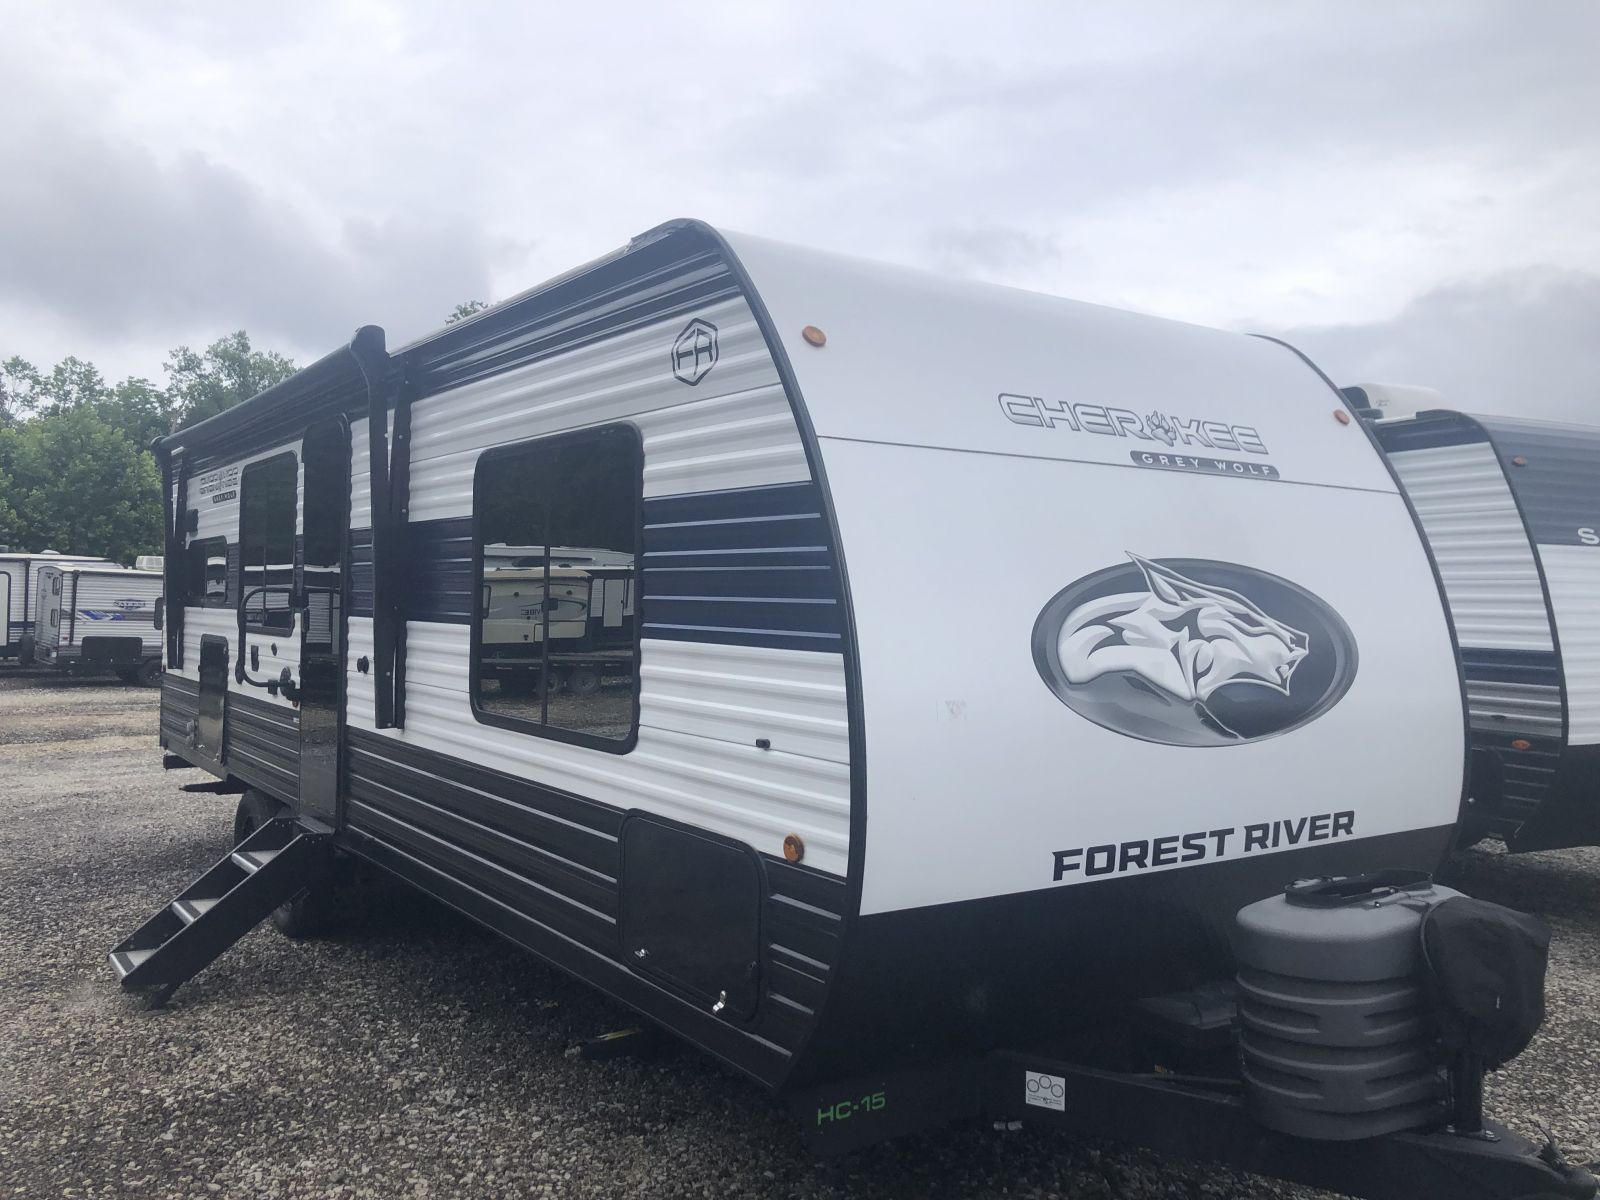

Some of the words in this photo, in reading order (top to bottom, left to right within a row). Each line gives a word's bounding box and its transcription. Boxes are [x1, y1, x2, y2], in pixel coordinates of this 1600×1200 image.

[1141, 453, 1200, 469] GREY
[1214, 460, 1270, 476] WOLF
[1051, 827, 1235, 882] FOREST
[1243, 810, 1355, 852] RIVER
[817, 1091, 886, 1126] HC-15
